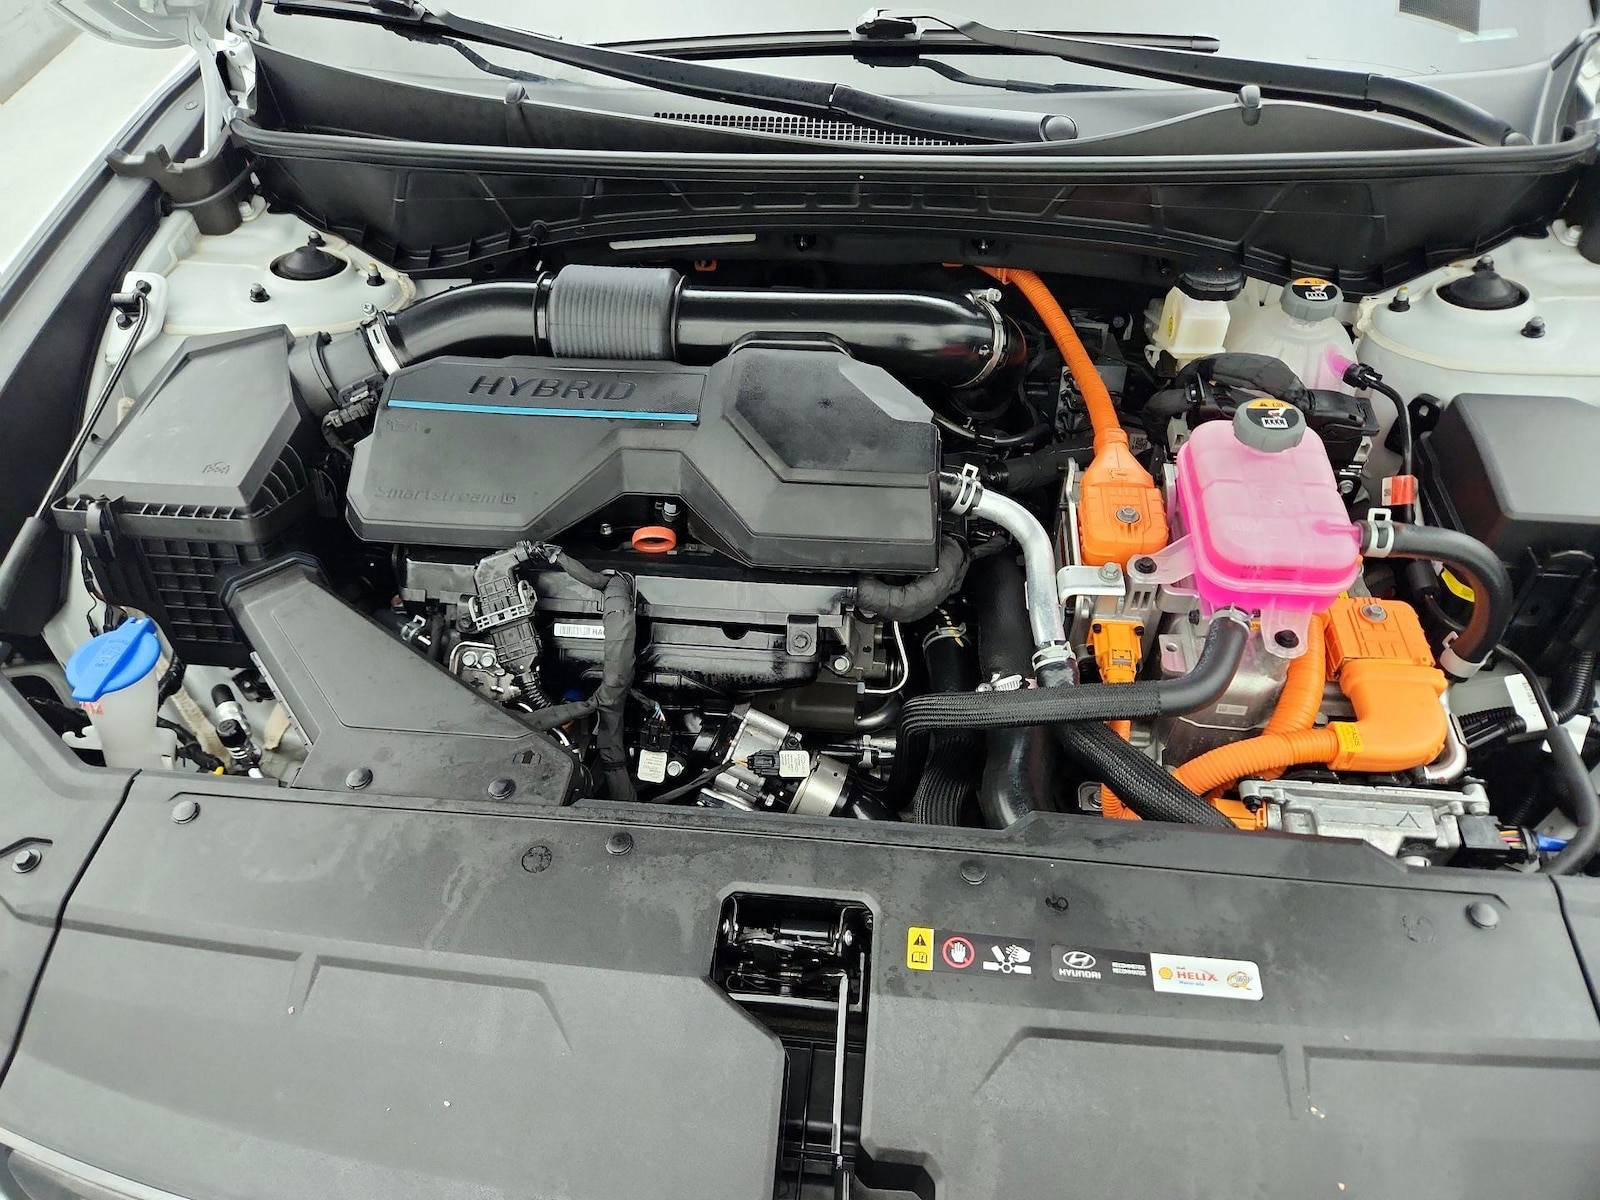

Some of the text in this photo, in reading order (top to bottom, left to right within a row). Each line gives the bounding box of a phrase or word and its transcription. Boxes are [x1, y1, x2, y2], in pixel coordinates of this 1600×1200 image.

[467, 375, 638, 400] HYBRID
[374, 486, 497, 504] Smartstream
[1059, 968, 1102, 979] HYUNDAI
[1176, 970, 1218, 982] HELIX
